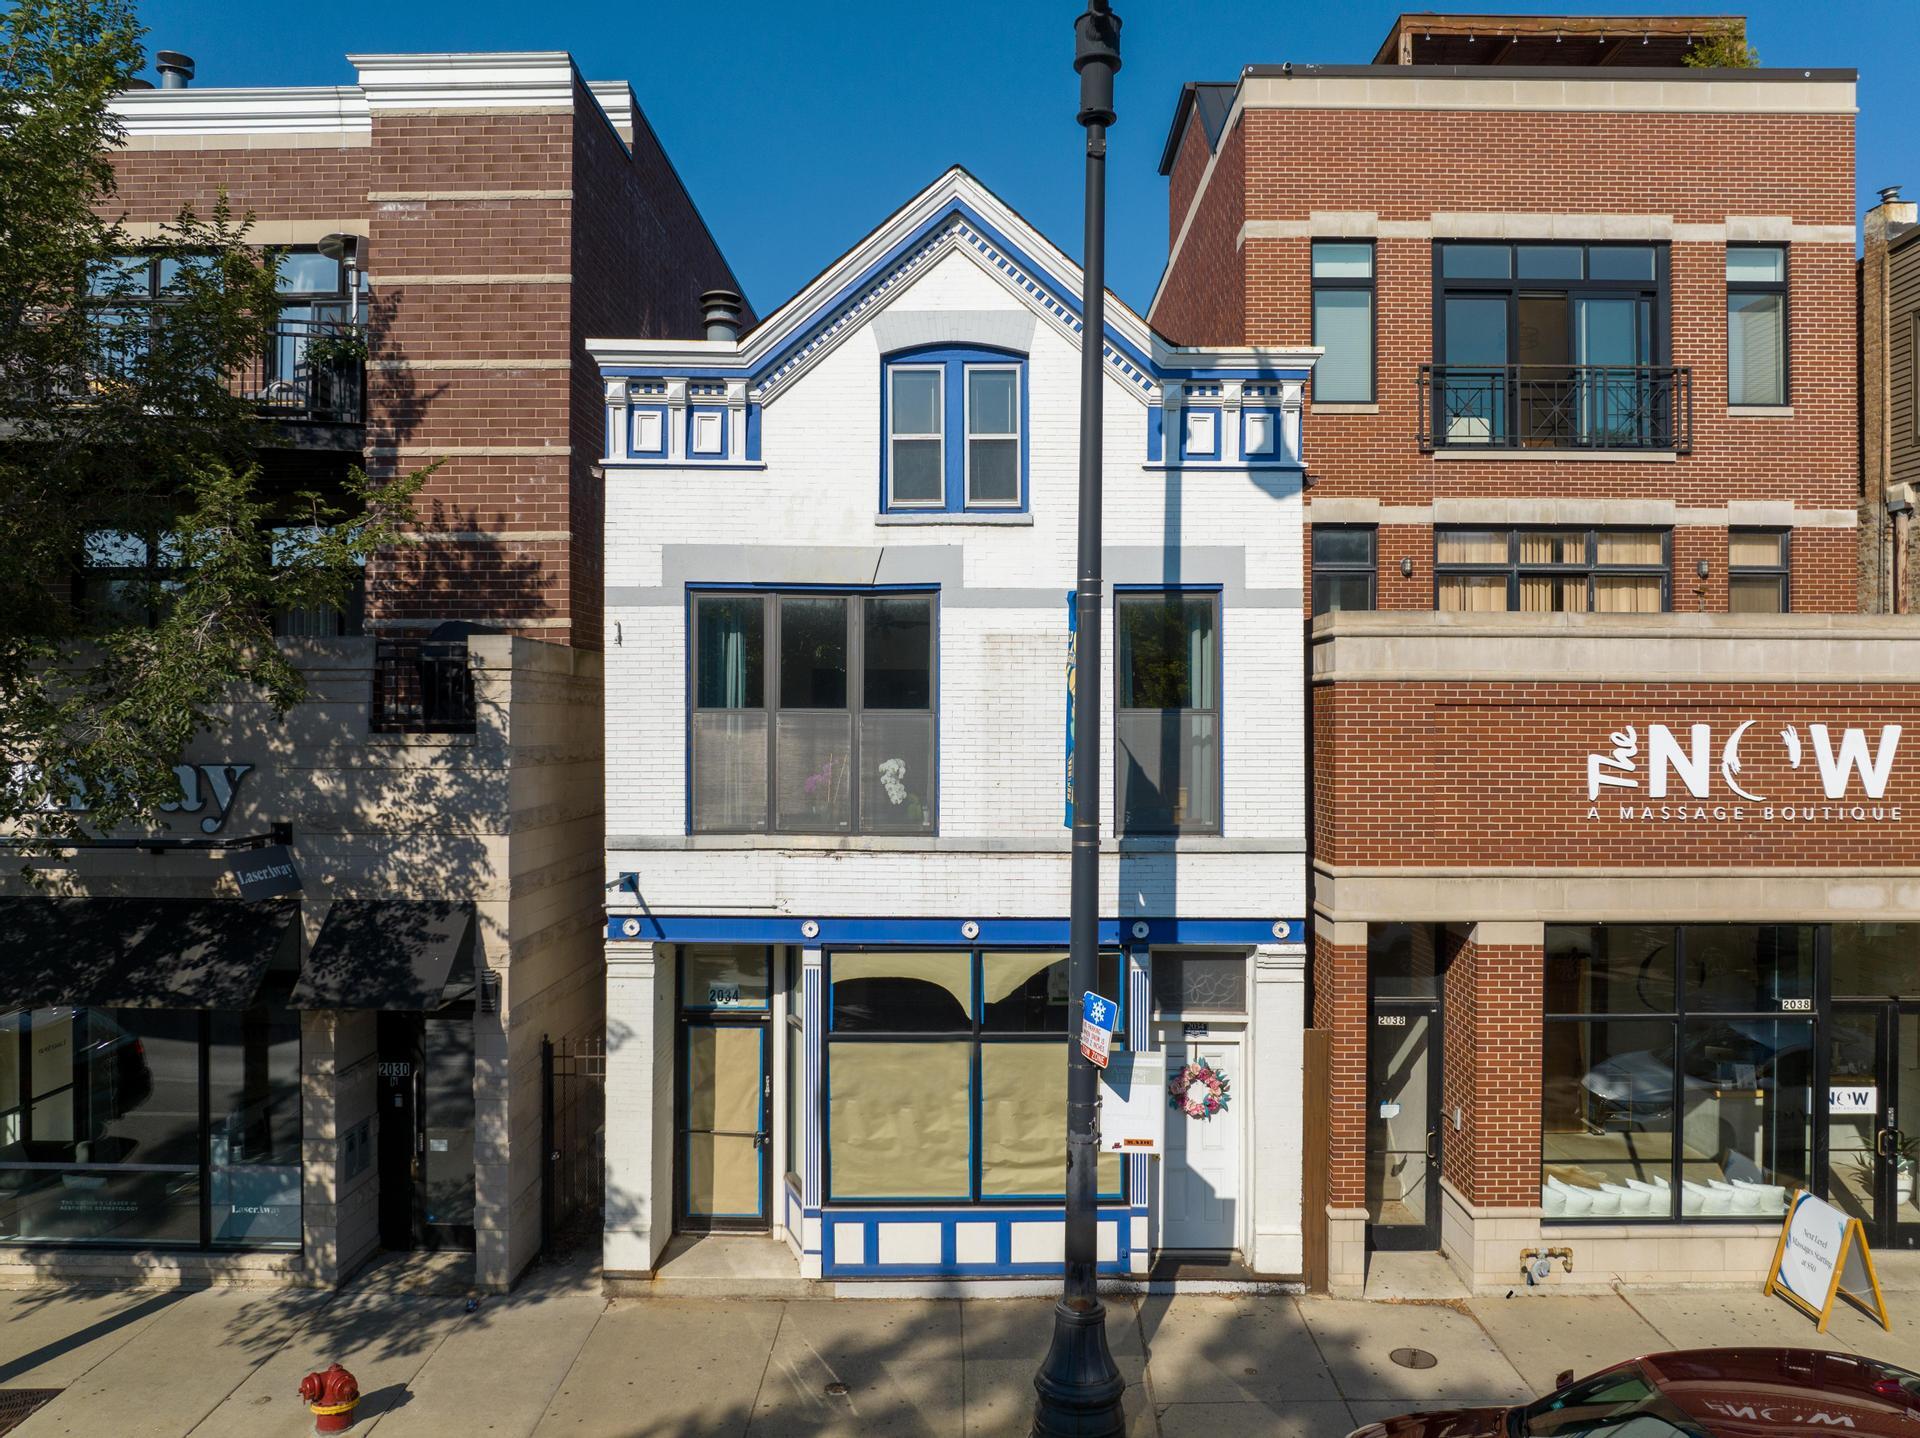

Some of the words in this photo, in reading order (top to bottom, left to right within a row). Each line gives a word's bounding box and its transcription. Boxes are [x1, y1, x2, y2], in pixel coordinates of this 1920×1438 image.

[1587, 725, 1639, 801] The
[1587, 807, 1600, 820] A
[1620, 806, 1744, 820] MASSAGE
[1763, 806, 1902, 821] BOUTIQUE
[236, 864, 292, 885] LaserAway
[709, 989, 739, 1004] 2034
[1783, 1000, 1810, 1009] 2038
[1379, 1016, 1406, 1025] 2038
[1092, 1050, 1106, 1066] ZONE
[380, 1063, 408, 1075] 2030
[232, 1204, 280, 1216] LaserAway
